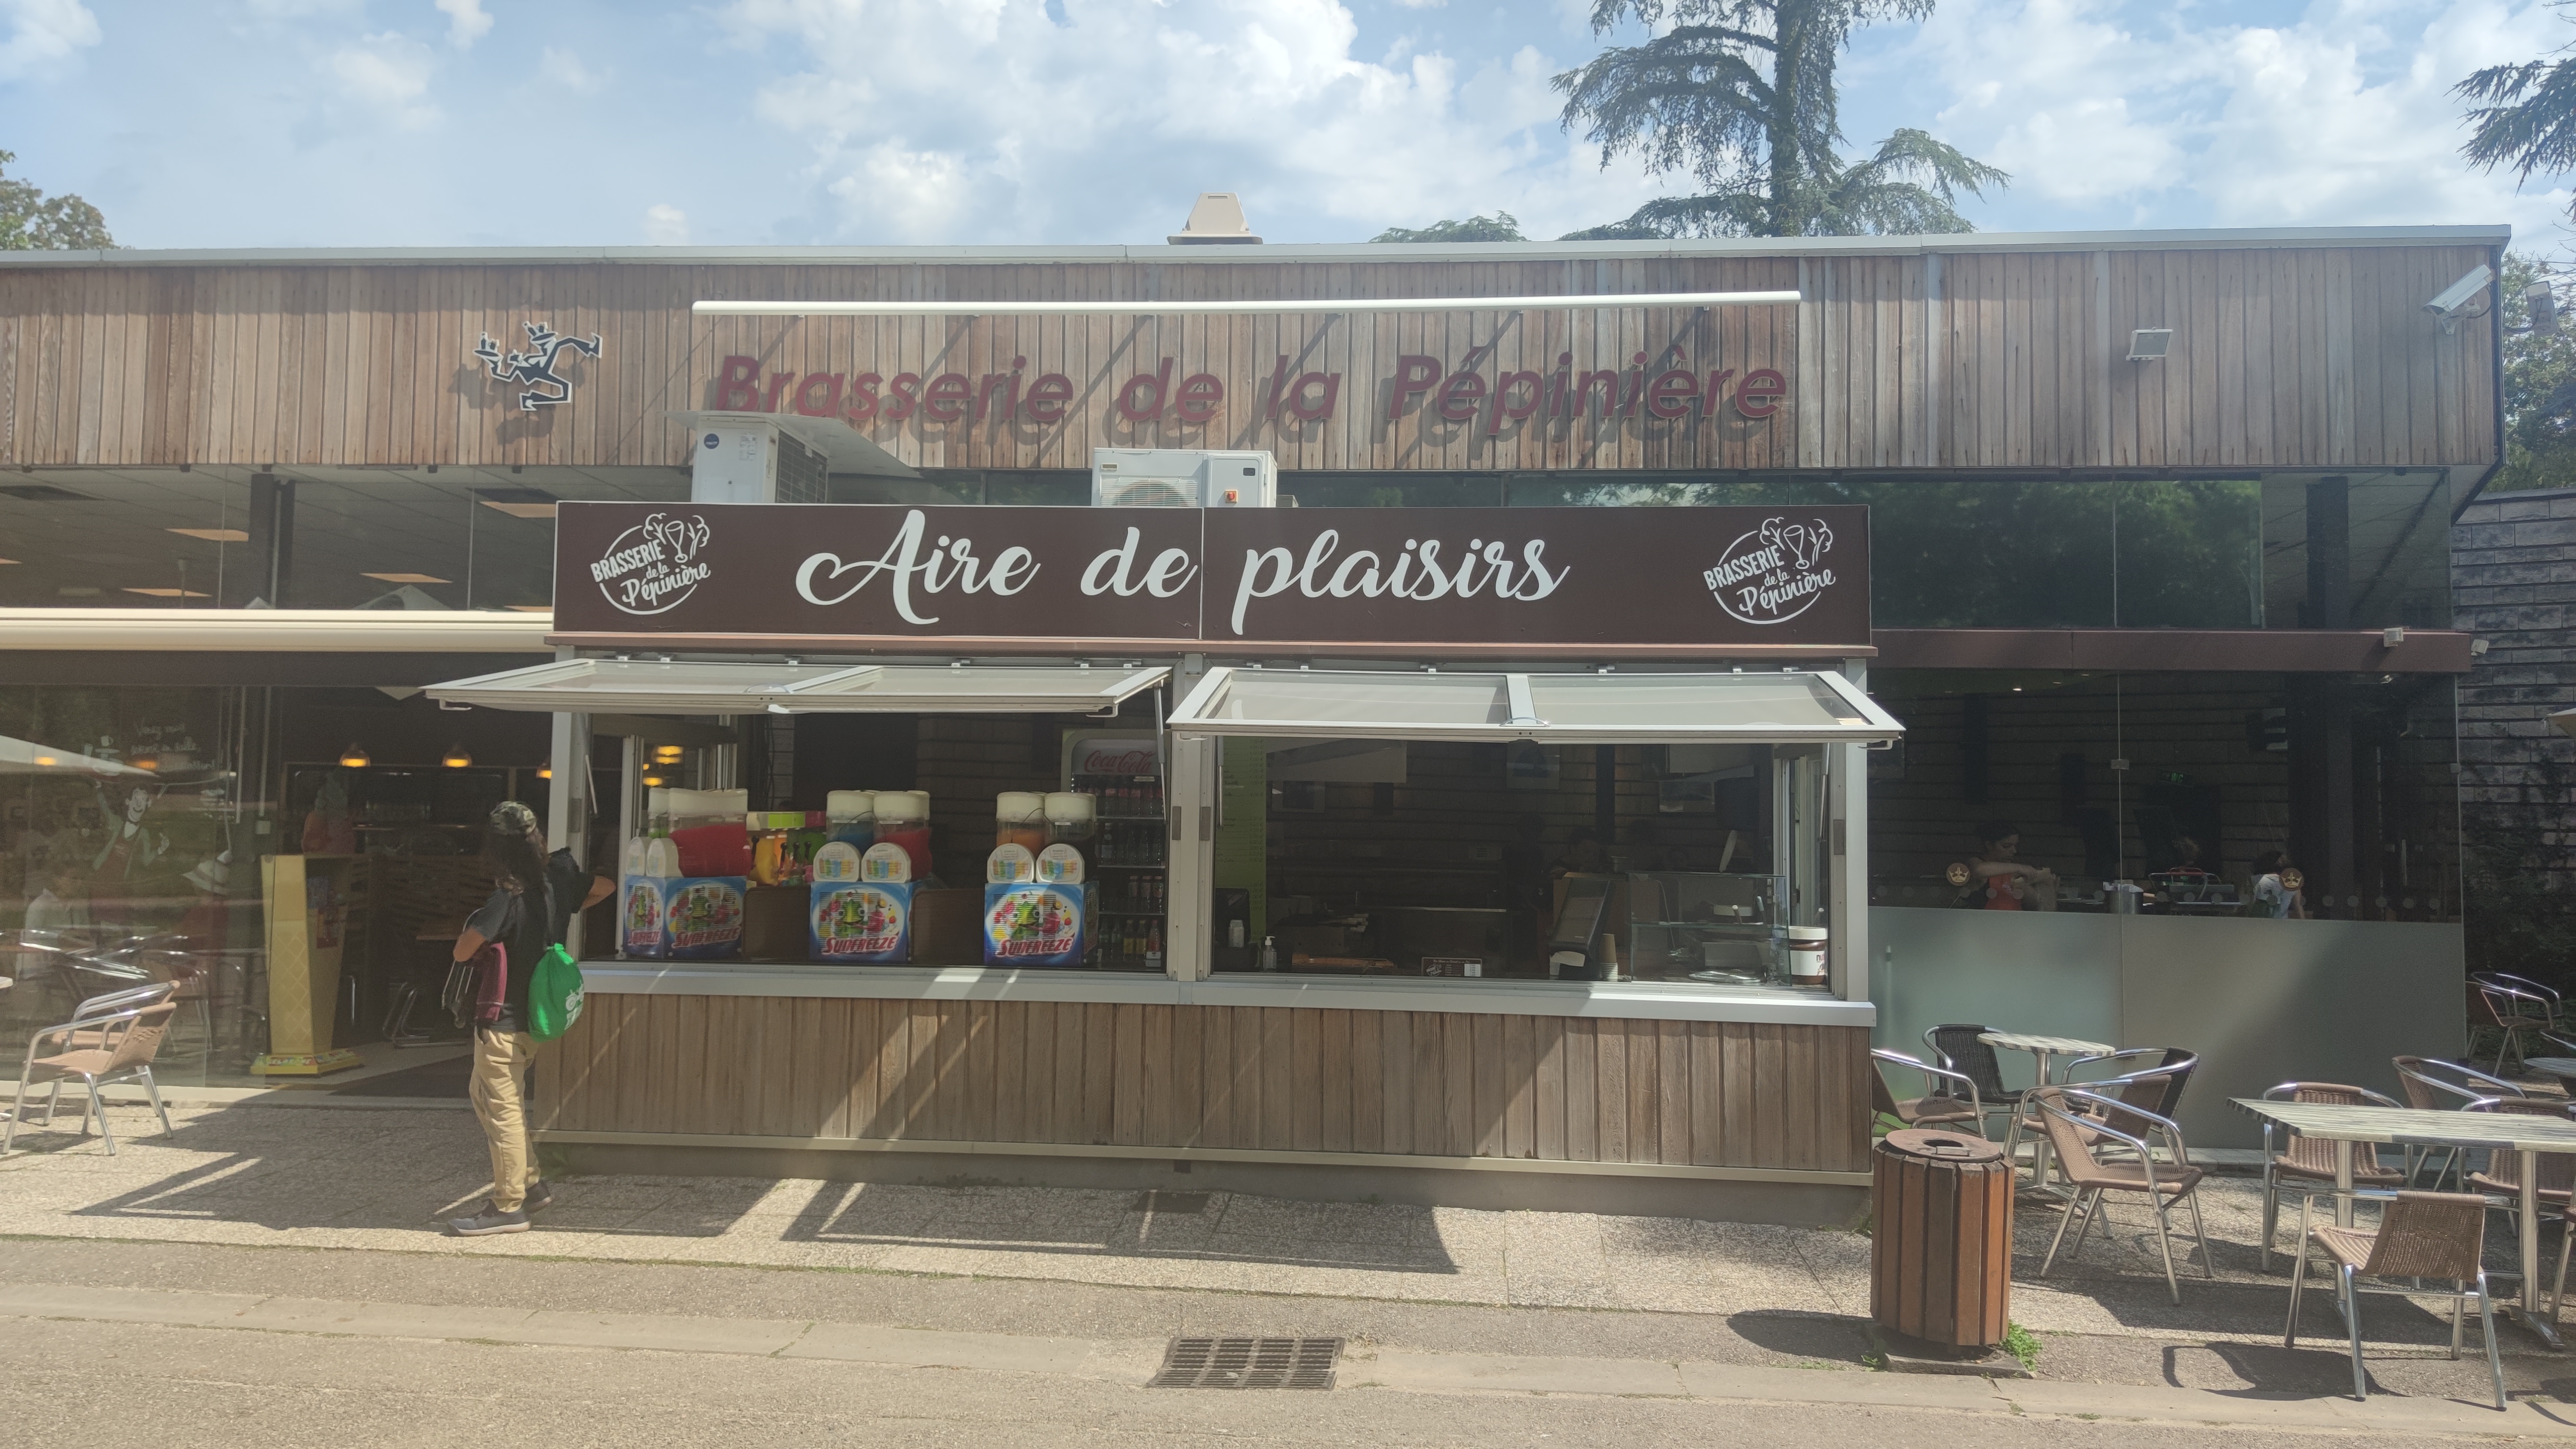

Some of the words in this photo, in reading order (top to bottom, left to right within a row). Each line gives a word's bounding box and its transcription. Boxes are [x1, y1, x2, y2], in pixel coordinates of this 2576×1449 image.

[716, 355, 1074, 422] Brasserie
[1118, 357, 1224, 423] de
[1265, 354, 1342, 421] la
[1387, 345, 1787, 436] Pépinière
[590, 538, 665, 582] BRASSERIE
[646, 565, 659, 579] de
[657, 561, 670, 574] la
[796, 509, 1041, 624] Aire
[1080, 526, 1198, 597] de
[1231, 529, 1571, 635] plaisirs
[1703, 545, 1785, 591] BRASSERIE
[1764, 572, 1778, 587] de
[1776, 568, 1790, 581] la
[620, 562, 711, 607] Pépinière
[1736, 569, 1836, 616] Pépinière
